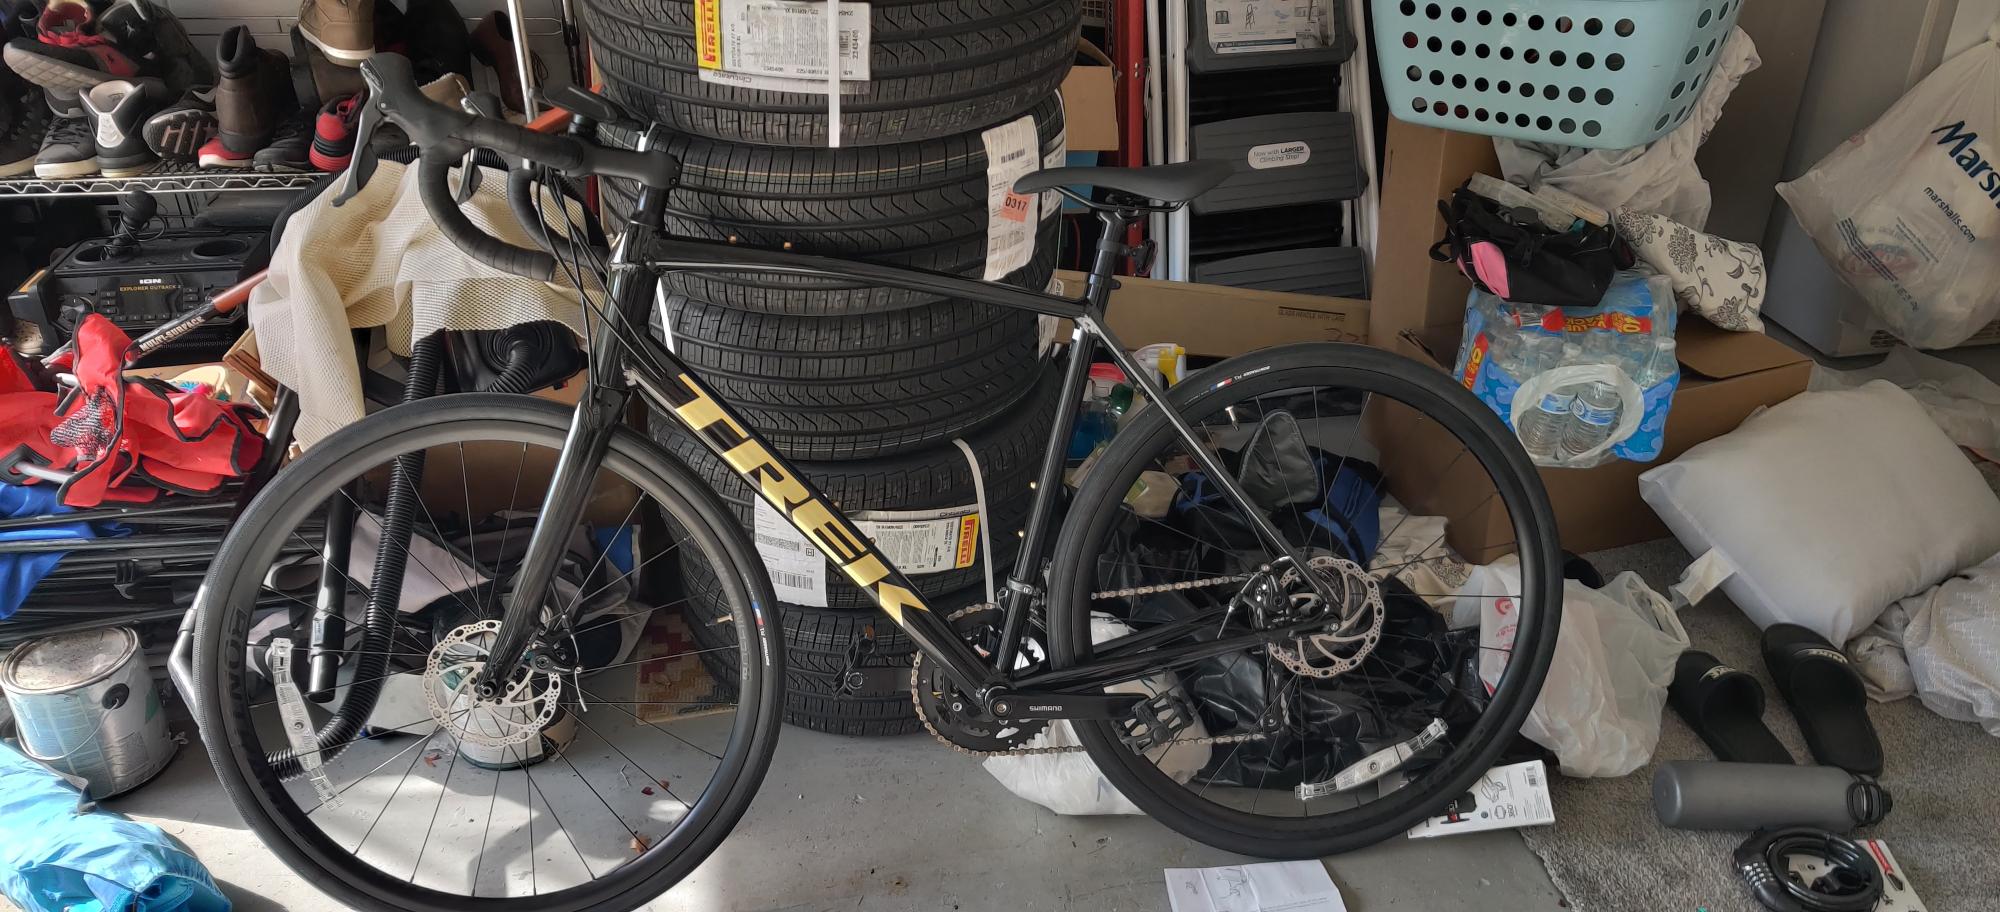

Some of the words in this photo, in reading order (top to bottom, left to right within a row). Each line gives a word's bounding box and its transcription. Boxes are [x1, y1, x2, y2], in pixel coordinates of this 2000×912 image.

[1281, 146, 1305, 154] LARGER
[1005, 196, 1027, 212] 0317
[1923, 186, 1976, 243] marshalls.com
[139, 316, 206, 352] MULTI-SURFACE
[675, 372, 931, 627] TREK
[960, 518, 976, 566] PIRELLI
